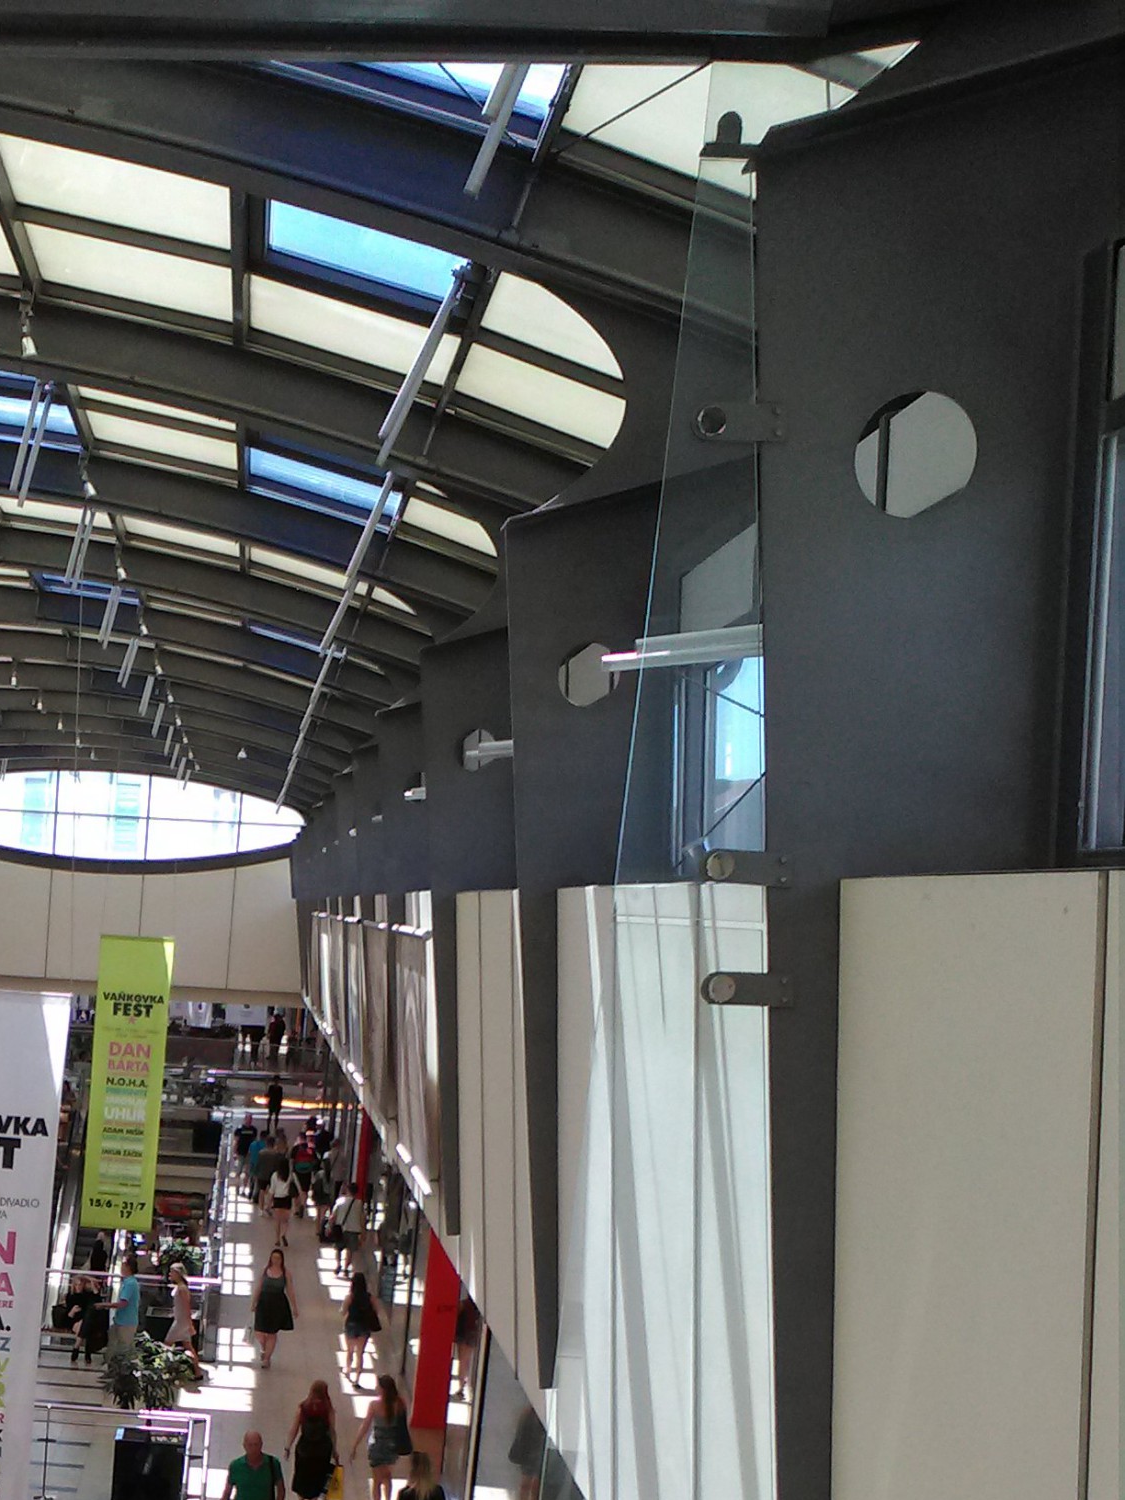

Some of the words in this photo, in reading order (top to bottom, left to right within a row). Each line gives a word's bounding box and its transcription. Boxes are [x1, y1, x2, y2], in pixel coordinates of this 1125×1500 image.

[103, 991, 164, 1004] VAŇKOVKA
[113, 1002, 153, 1018] FEST
[109, 1041, 151, 1059] DAN
[0, 1197, 40, 1209] DIVADLO
[120, 1210, 132, 1219] 17
